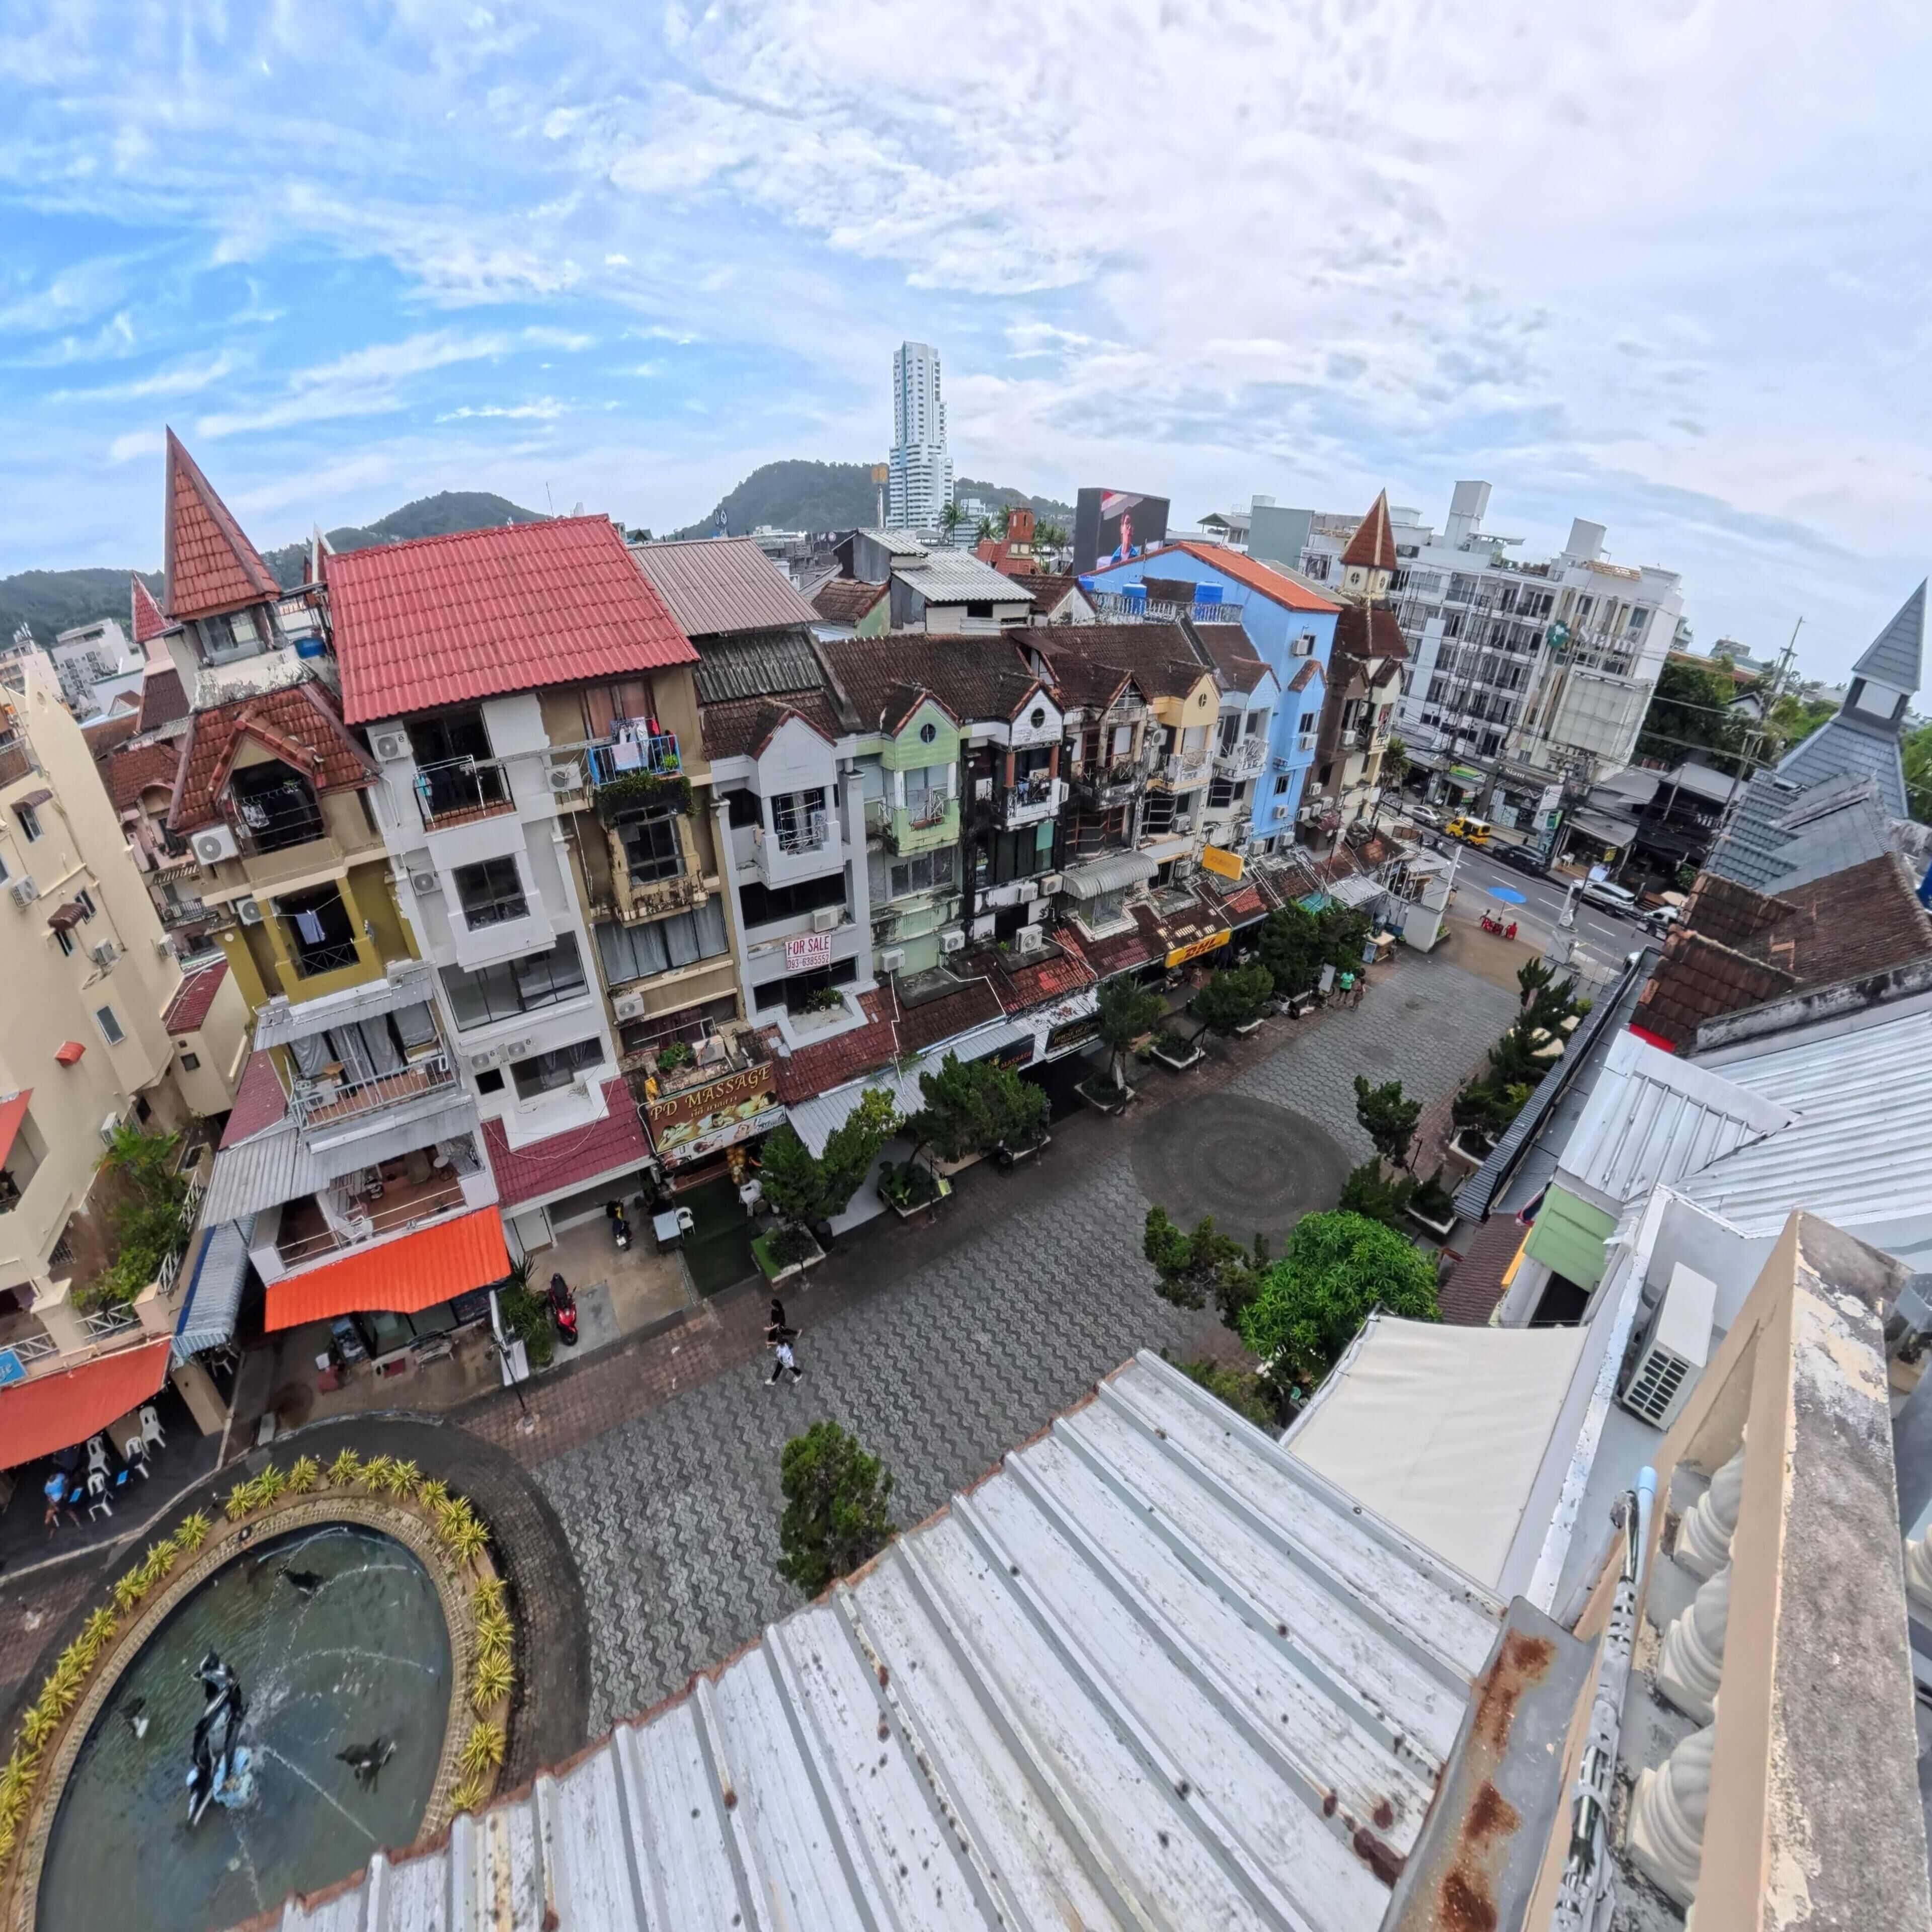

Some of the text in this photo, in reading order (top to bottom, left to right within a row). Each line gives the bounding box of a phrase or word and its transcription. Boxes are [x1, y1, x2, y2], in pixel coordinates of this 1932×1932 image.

[1576, 625, 1635, 653] Siam
[1505, 767, 1525, 779] Siam
[787, 936, 829, 955] FOR SALE
[1183, 938, 1216, 959] DHL
[787, 954, 829, 969] 093-6385552
[1000, 1050, 1031, 1070] MASSAGE
[651, 1065, 772, 1121] PD MASSAGE
